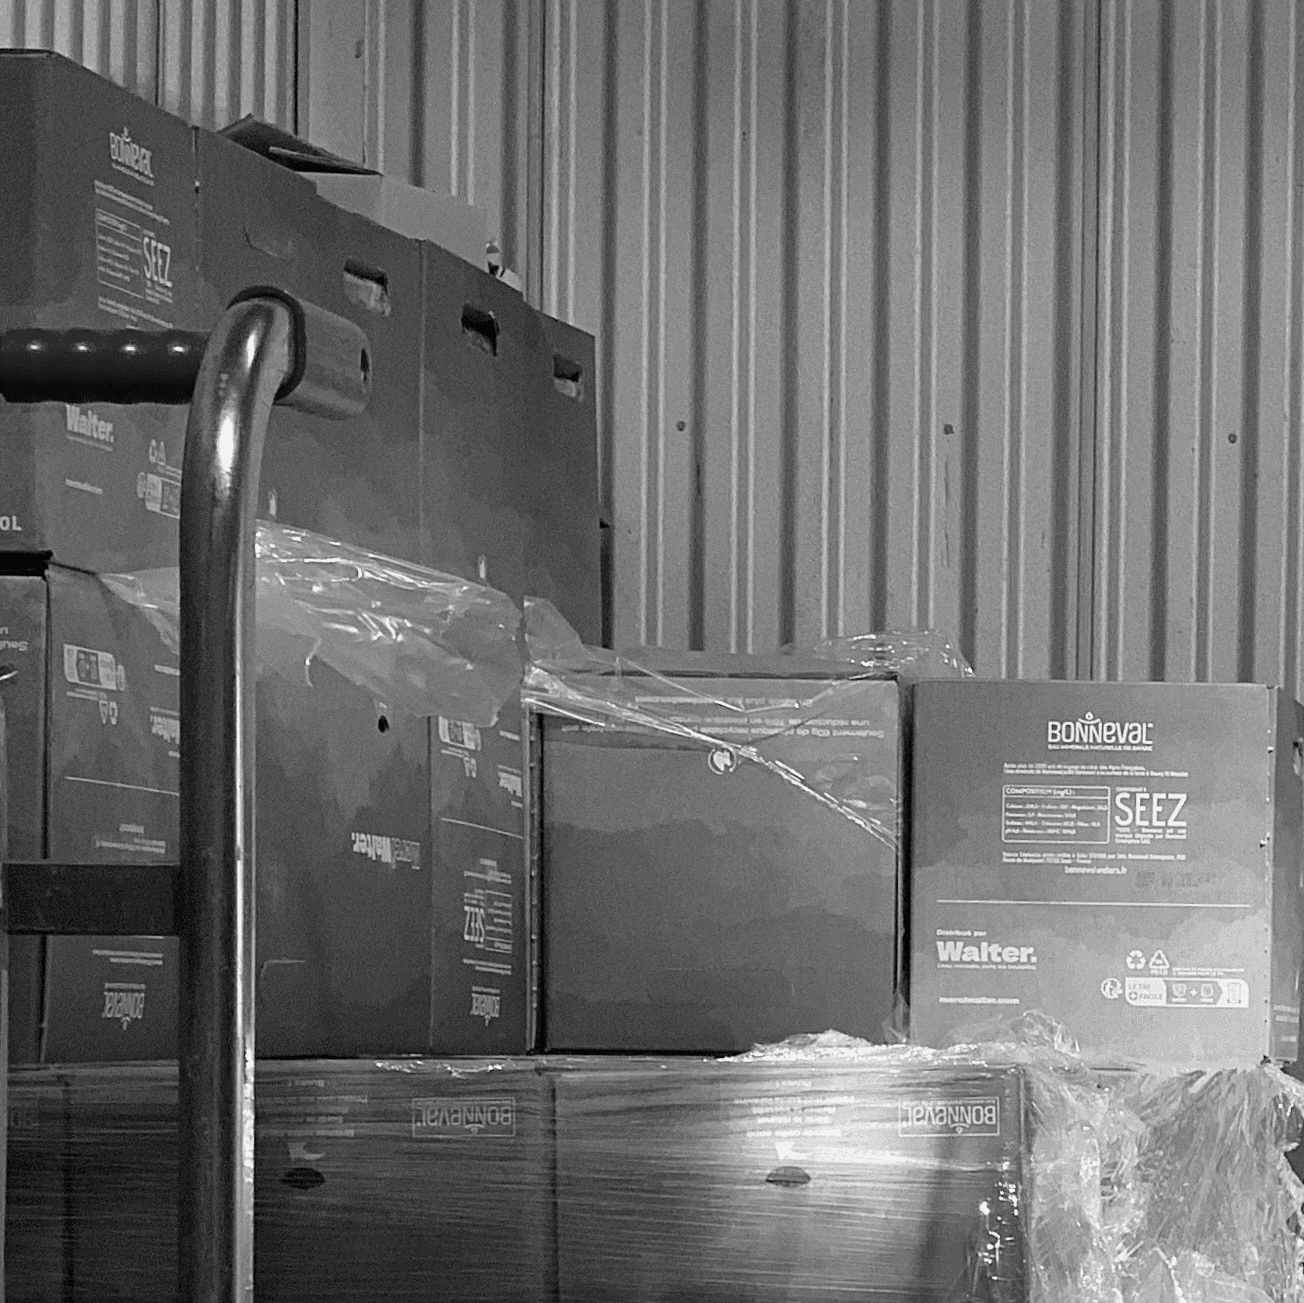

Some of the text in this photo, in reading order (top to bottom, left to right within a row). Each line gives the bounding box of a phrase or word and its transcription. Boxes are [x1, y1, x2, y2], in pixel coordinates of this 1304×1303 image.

[143, 236, 173, 288] SEEZ
[66, 404, 114, 443] Walter.
[1048, 719, 1154, 744] BONNEVAL
[1114, 792, 1187, 827] SEEZ
[936, 941, 1038, 963] Walter.
[415, 1104, 512, 1127] BONNEVAL
[902, 1104, 997, 1126] BONNEVAL
